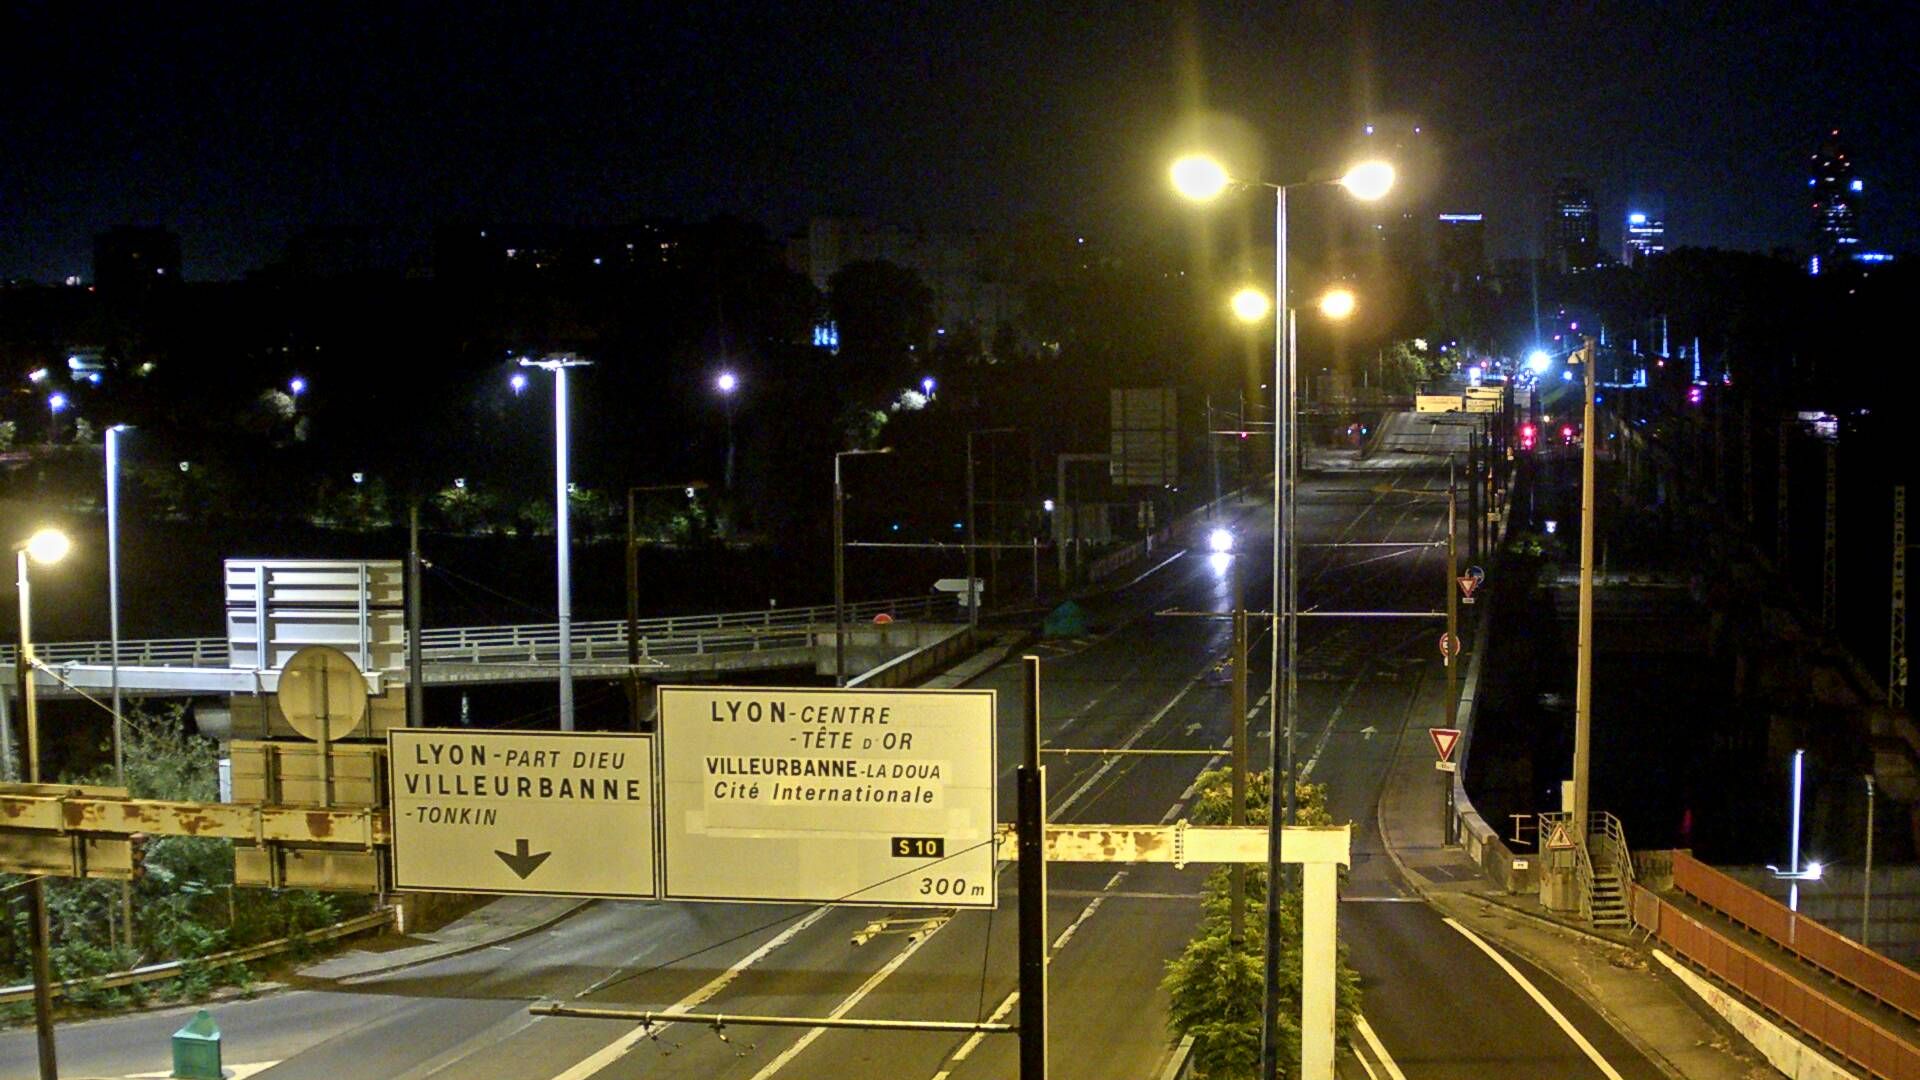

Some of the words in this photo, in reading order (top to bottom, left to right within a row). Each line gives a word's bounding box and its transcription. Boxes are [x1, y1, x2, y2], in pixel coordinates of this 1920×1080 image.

[573, 751, 626, 769] DIEU
[892, 764, 941, 779] DOUA
[404, 773, 641, 801] VILLEURBANNE
[714, 781, 760, 799] Cité
[773, 782, 934, 804] Internationale
[915, 840, 937, 855] 10
[920, 877, 967, 895] 300
[970, 884, 985, 896] m
